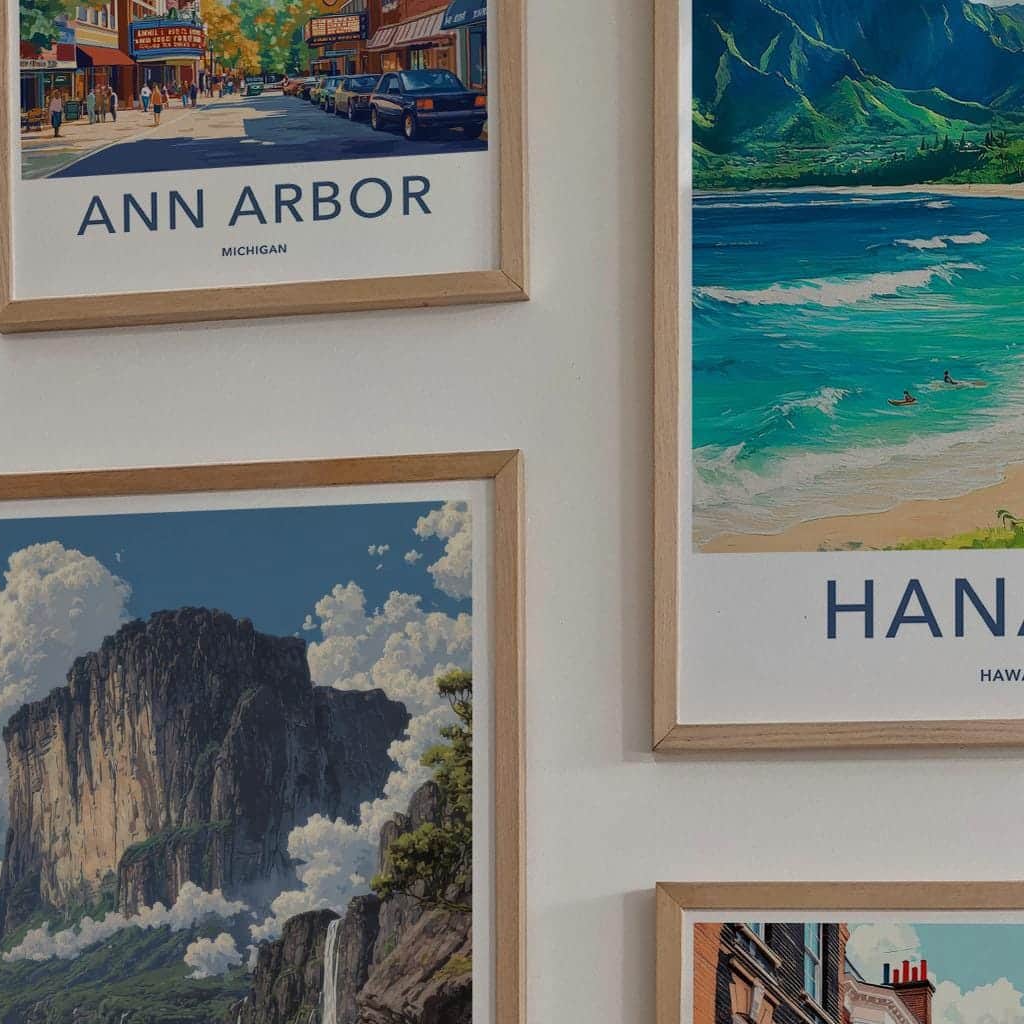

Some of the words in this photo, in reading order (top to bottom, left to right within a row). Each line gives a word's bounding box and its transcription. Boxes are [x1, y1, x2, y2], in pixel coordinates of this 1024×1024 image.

[76, 188, 205, 236] ANN
[227, 175, 433, 227] ARBOR
[221, 243, 288, 258] MICHIGAN
[826, 577, 1024, 639] HAN
[980, 668, 1024, 682] HAW
